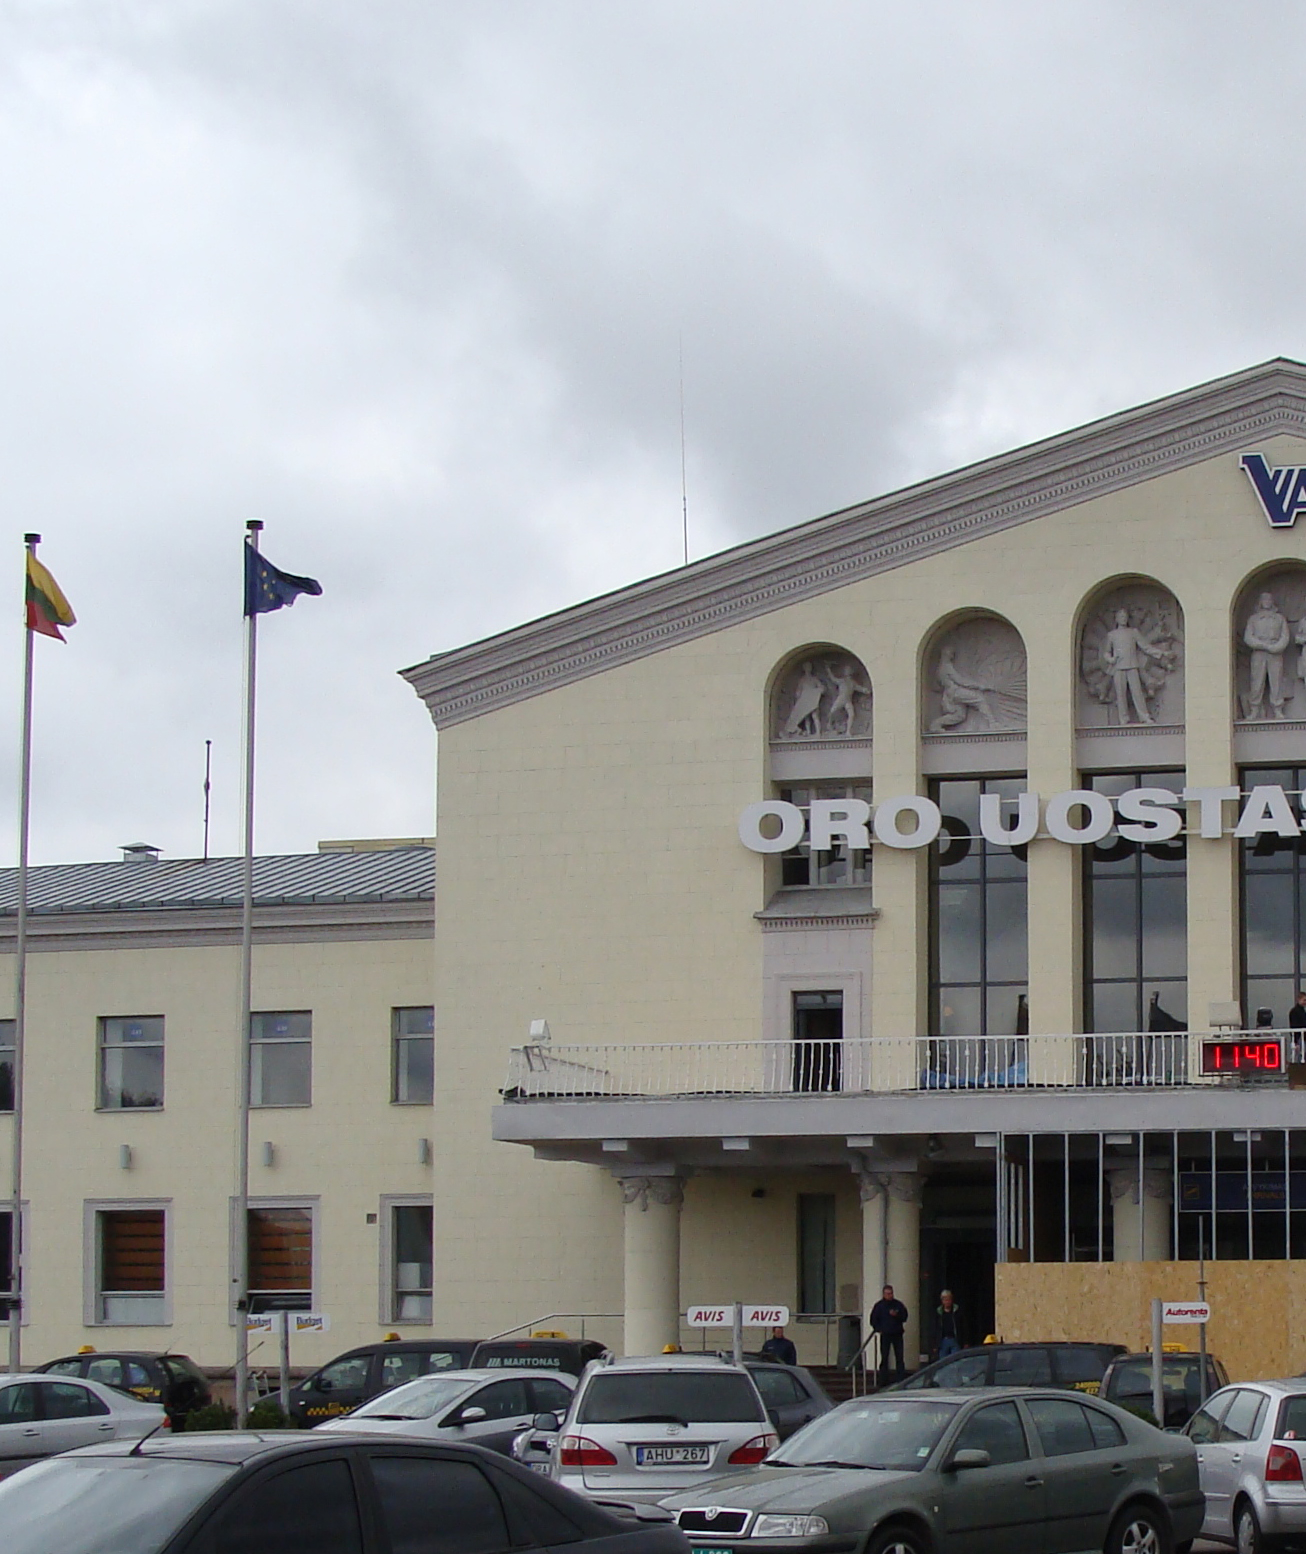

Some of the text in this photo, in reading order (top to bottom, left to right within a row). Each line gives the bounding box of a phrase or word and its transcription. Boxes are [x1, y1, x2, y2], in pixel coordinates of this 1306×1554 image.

[738, 795, 942, 853] ORO
[296, 1316, 322, 1326] Budget
[694, 1311, 725, 1322] AVIS
[750, 1311, 782, 1322] AVIS
[503, 1357, 560, 1366] MARTONAS
[646, 1448, 706, 1461] AHU 267
